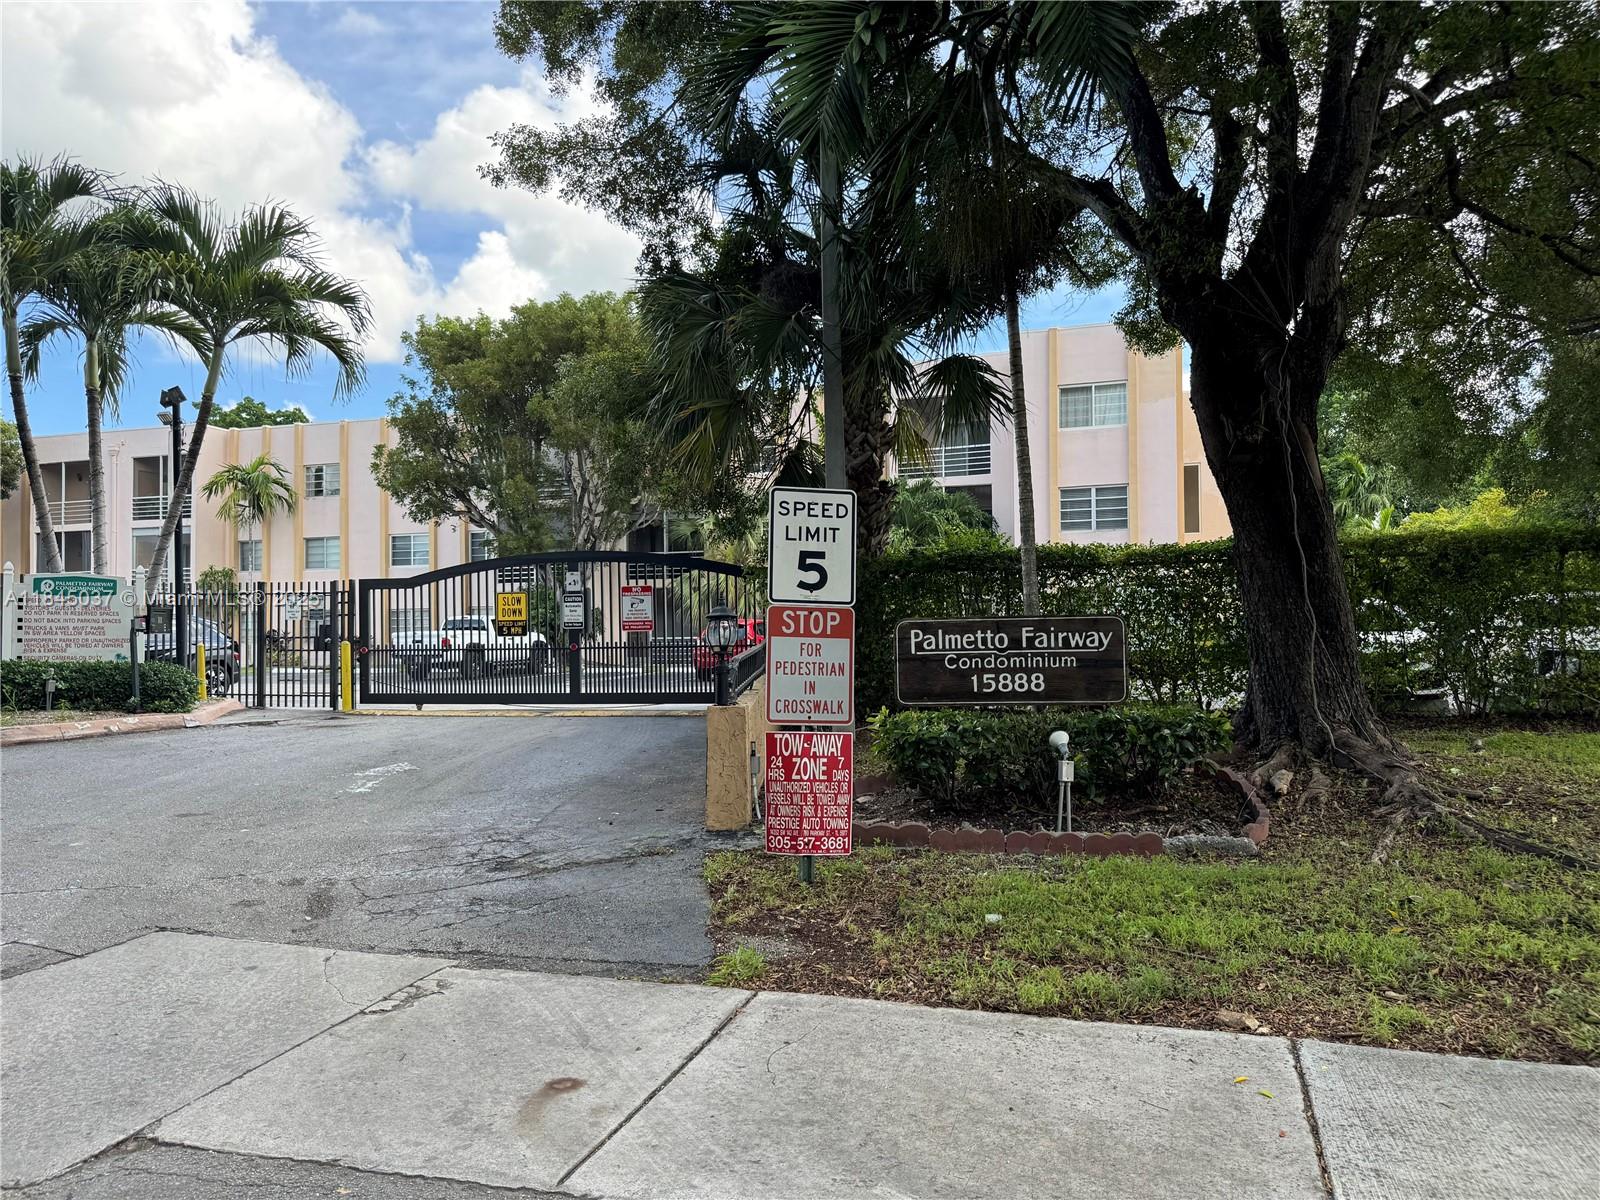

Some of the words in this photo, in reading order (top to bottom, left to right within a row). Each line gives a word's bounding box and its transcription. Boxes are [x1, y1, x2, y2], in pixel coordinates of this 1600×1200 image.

[778, 501, 849, 519] SPEED
[785, 525, 840, 543] LIMIT
[796, 550, 828, 591] 5
[502, 596, 522, 606] SLOW
[501, 607, 523, 617] DOWN
[781, 610, 841, 635] STOP
[503, 627, 508, 635] 5
[511, 627, 523, 635] MPH
[910, 628, 1009, 654] Palmetto
[1021, 627, 1113, 651] Fairway
[800, 642, 822, 657] FOR
[944, 653, 1077, 669] Condominium
[775, 661, 845, 677] PEDESTRIAN
[804, 680, 816, 695] IN
[971, 672, 1046, 693] 15888
[775, 699, 844, 715] CROSSWALK
[774, 733, 844, 757] TOW-AWAY
[770, 756, 783, 768] 24
[791, 757, 828, 780] ZONE
[838, 757, 845, 769] 7
[768, 769, 785, 780] HRS
[832, 770, 850, 781] DAYS
[769, 781, 811, 793] UNAUTHORIZED
[813, 782, 839, 793] VEHICLES
[840, 782, 848, 793] OR
[767, 793, 791, 804] VESSELS
[792, 793, 805, 805] WILL
[807, 794, 815, 805] BE
[816, 794, 835, 805] TOWED
[837, 794, 850, 805] AWAY
[770, 805, 776, 816] AT
[777, 805, 801, 816] OWNERS
[802, 806, 816, 816] RISK
[823, 806, 848, 817] EXPENSE
[768, 816, 800, 829] PRESTIGE
[802, 818, 820, 829] AUTO
[823, 818, 849, 830] TOWING
